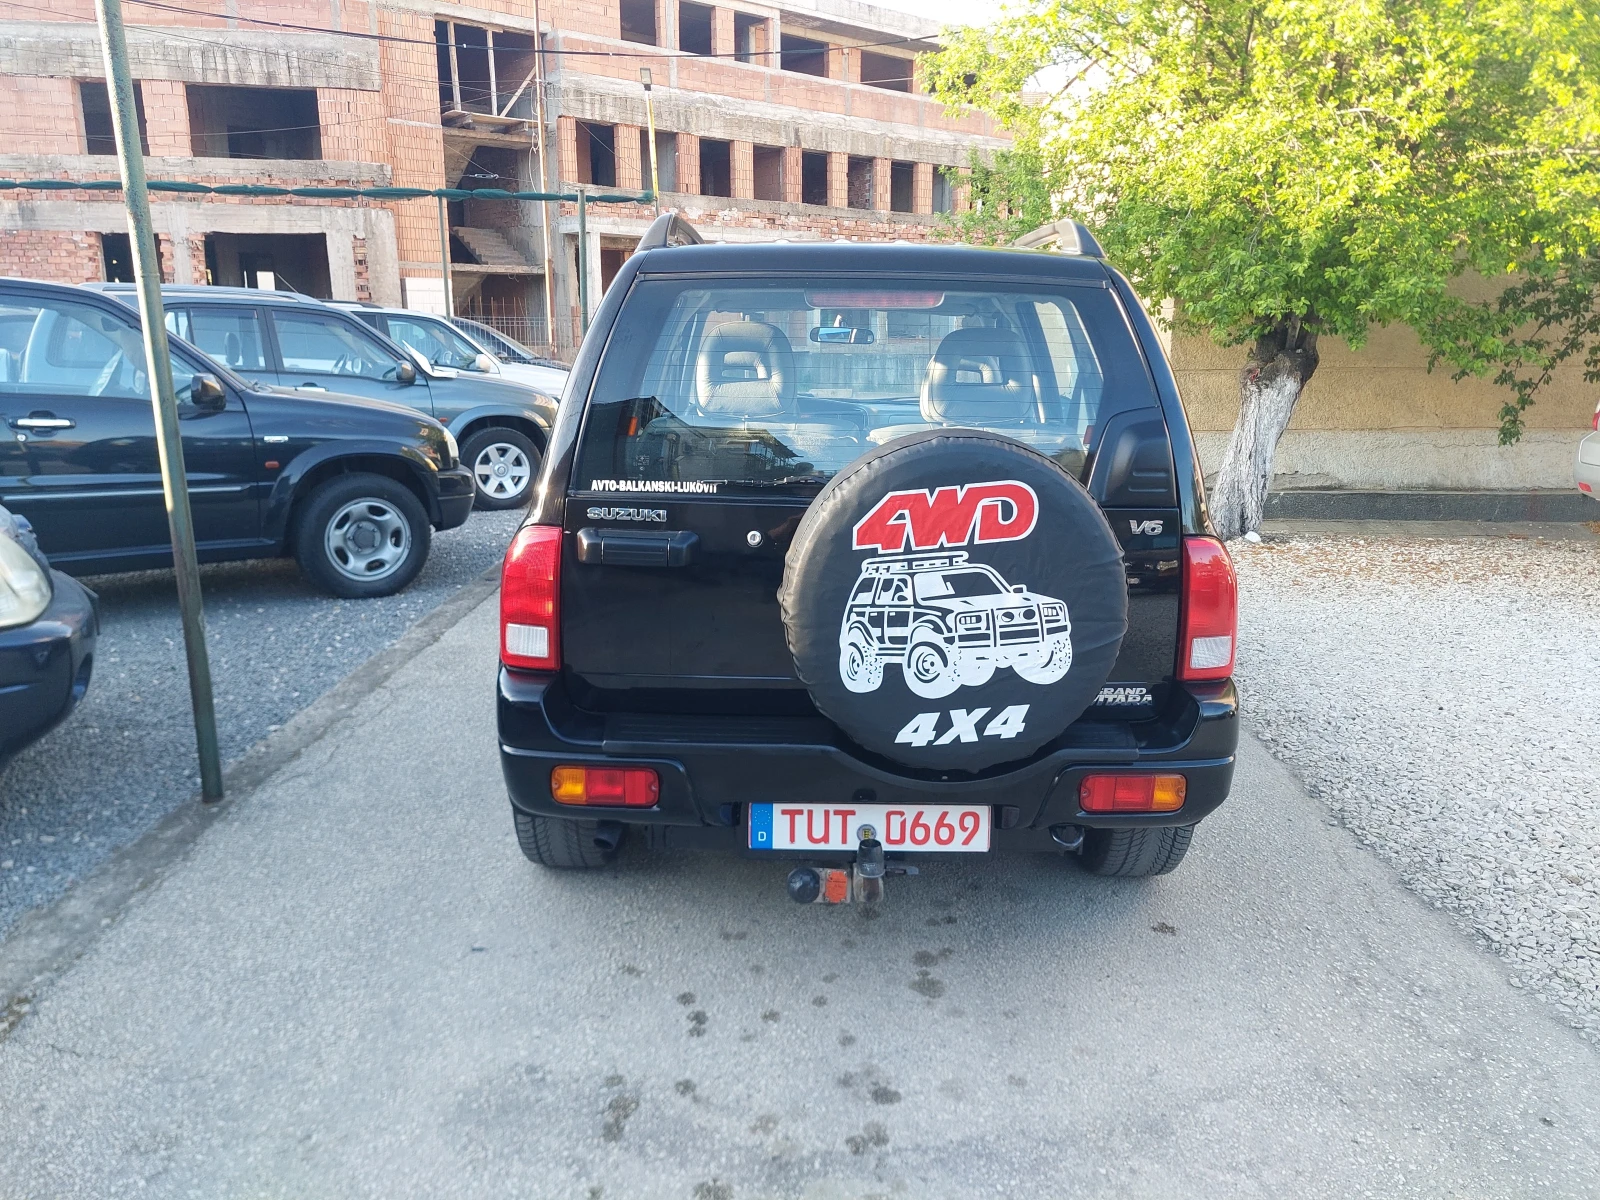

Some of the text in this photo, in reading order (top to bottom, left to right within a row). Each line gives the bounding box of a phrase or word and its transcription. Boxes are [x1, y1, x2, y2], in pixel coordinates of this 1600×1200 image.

[586, 507, 667, 522] SUZUKI
[852, 479, 1039, 554] 4WD
[1129, 519, 1164, 536] V6
[894, 704, 1030, 747] 4X4
[758, 809, 981, 846] D TUT 0669
